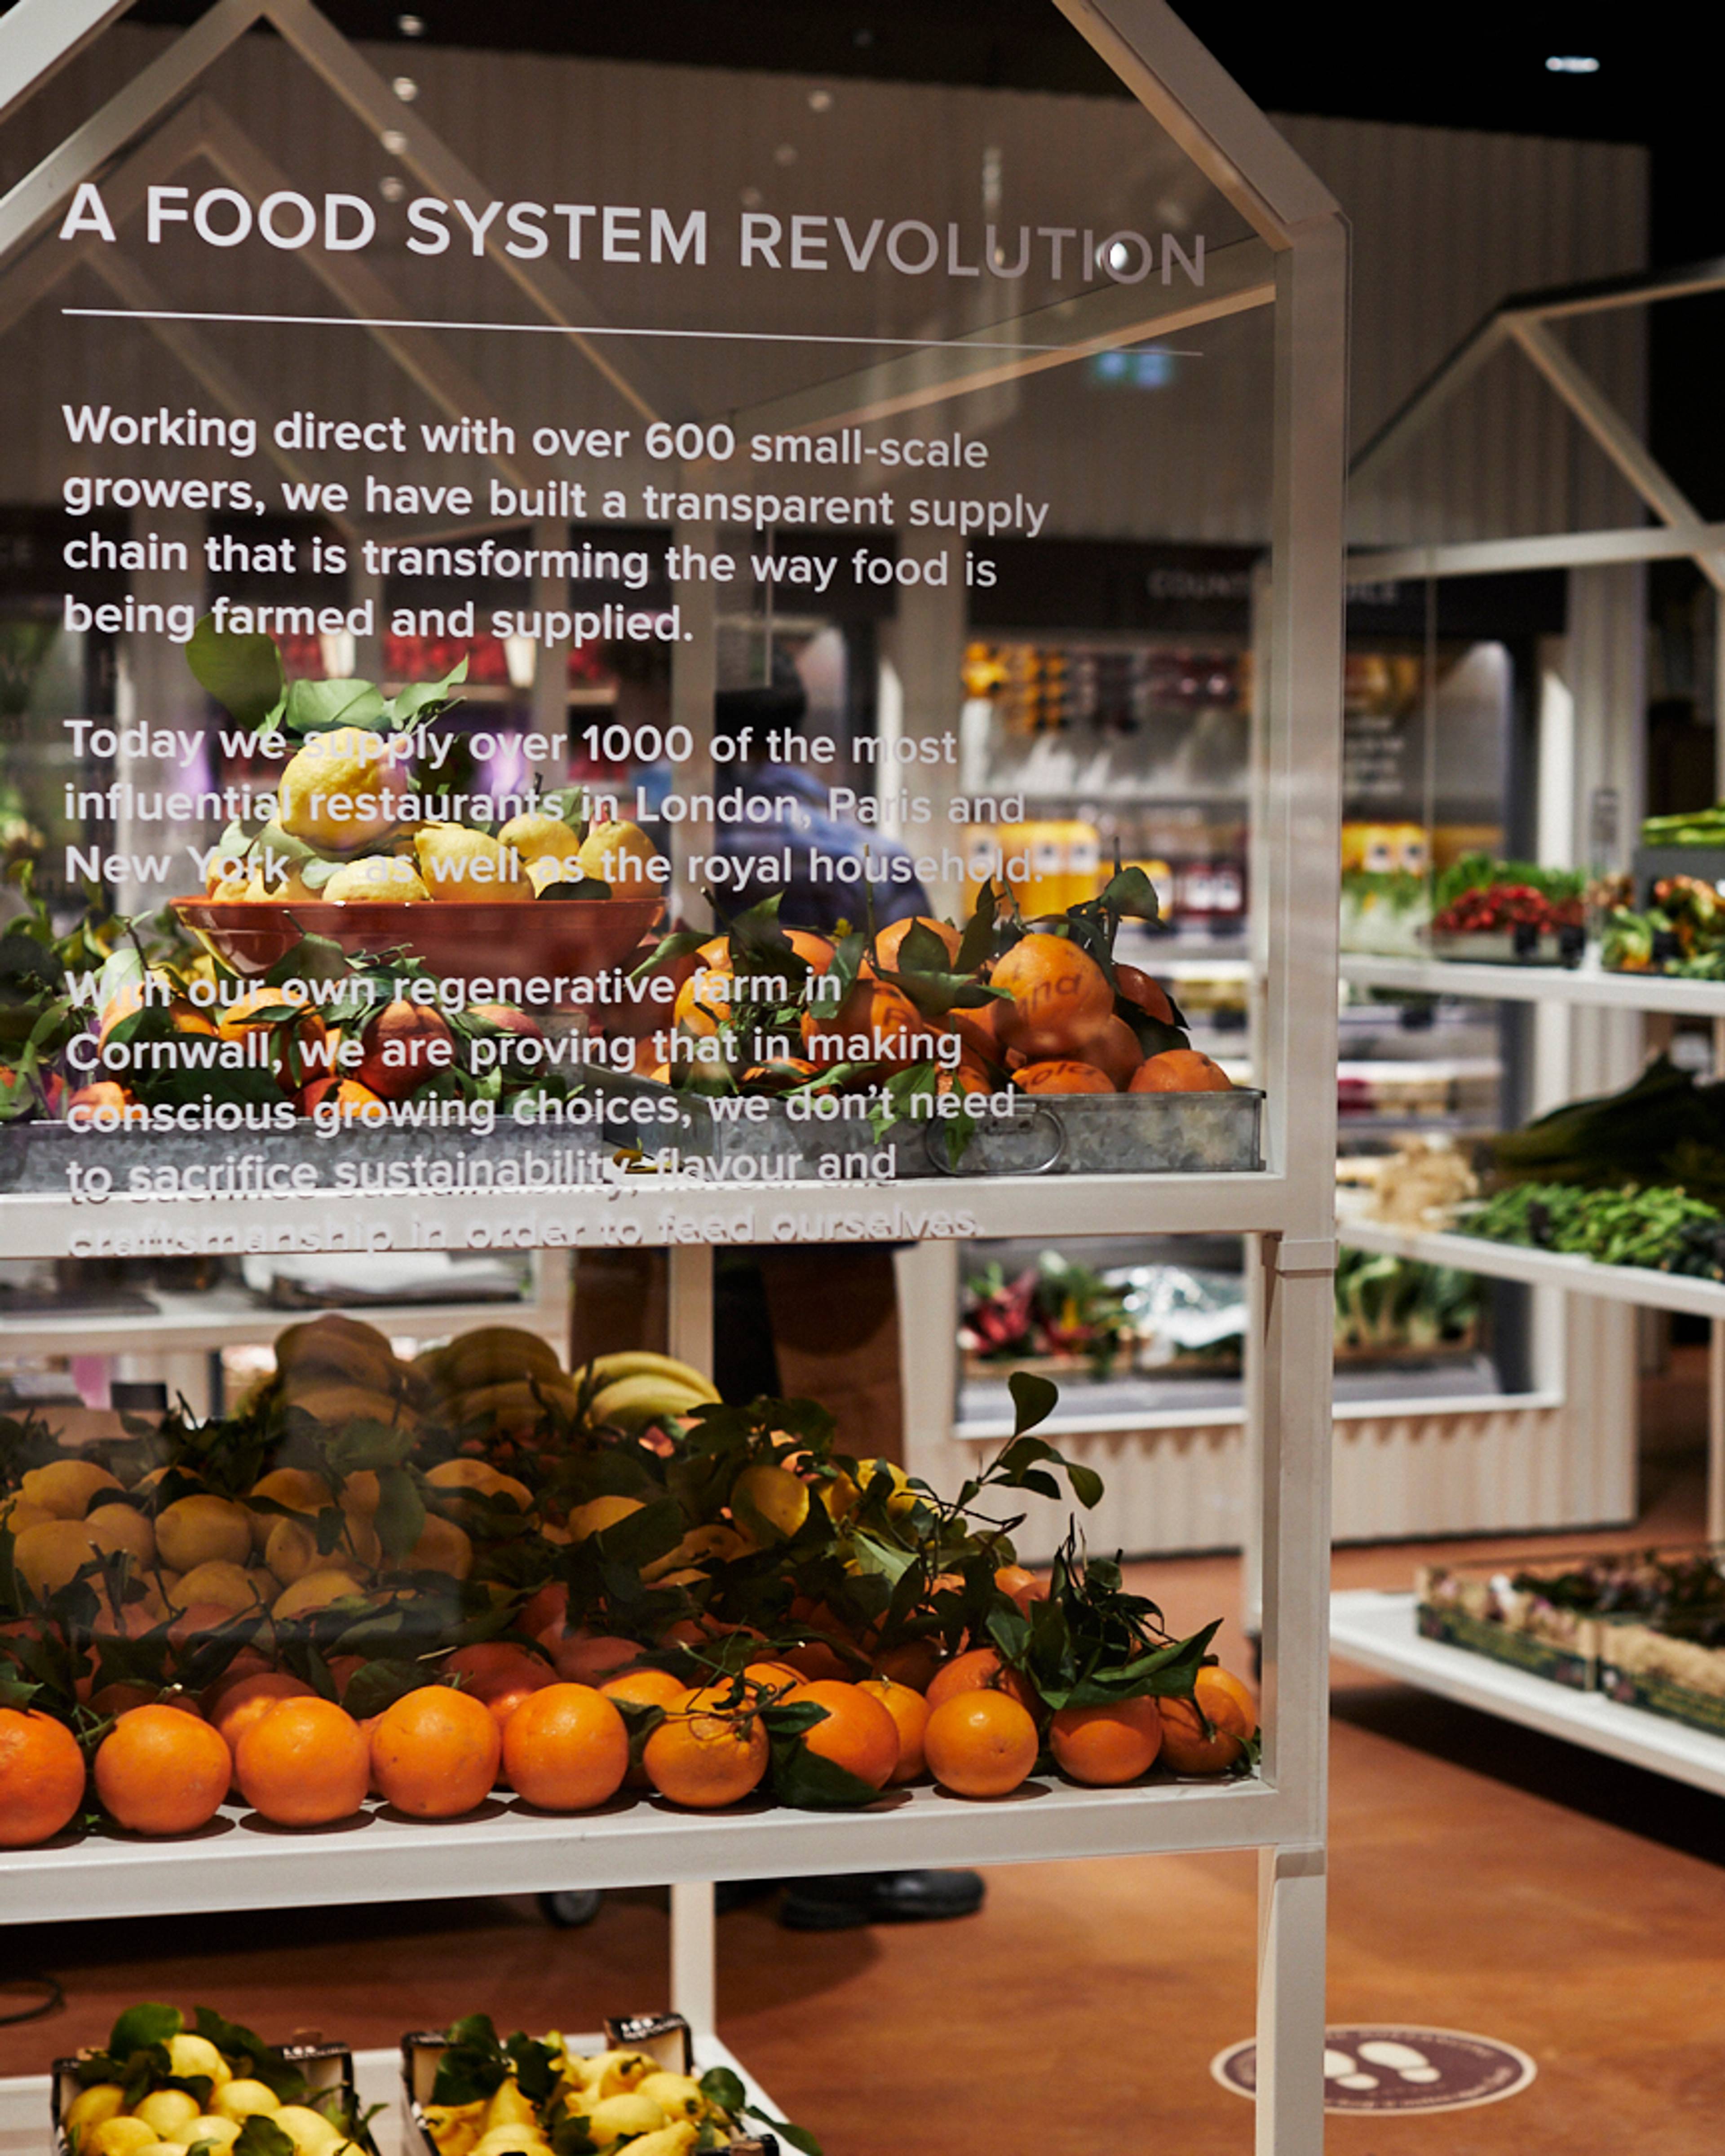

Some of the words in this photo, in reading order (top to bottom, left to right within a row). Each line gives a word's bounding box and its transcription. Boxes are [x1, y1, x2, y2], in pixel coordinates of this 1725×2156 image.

[59, 183, 116, 242] A
[147, 186, 376, 251] FOOD
[406, 198, 707, 265] SYSTEM
[740, 212, 1205, 286] REVOLUTION
[62, 404, 257, 456] Working
[274, 412, 405, 453] direct
[421, 416, 514, 454] with
[533, 429, 630, 458] over
[645, 423, 735, 461] 600
[751, 429, 989, 468] small-scale
[63, 472, 266, 516] growers,
[282, 482, 348, 512] we
[367, 477, 473, 514] have
[491, 480, 586, 517] built
[602, 490, 626, 519] a
[643, 485, 893, 529] transparent
[909, 494, 1049, 536] supply
[64, 533, 188, 570] chain
[204, 535, 296, 573] that
[314, 536, 347, 573] is
[363, 538, 649, 587] transforming
[666, 545, 735, 581] the
[752, 556, 838, 592] way
[853, 549, 948, 585] food
[965, 551, 997, 587] is
[64, 594, 195, 643] being
[211, 598, 374, 636] farmed
[391, 602, 475, 639] and
[491, 604, 692, 647] supplied.
[63, 720, 204, 767] Today
[219, 729, 286, 758] we
[303, 723, 454, 769] supply
[469, 732, 567, 761] over
[582, 725, 693, 764] 1000
[709, 727, 751, 763] of
[766, 727, 836, 763] the
[852, 730, 957, 764] most
[64, 783, 291, 821] influential
[310, 788, 564, 822] restaurants
[581, 787, 618, 822] in
[637, 787, 810, 829] London,
[829, 787, 931, 825] Paris
[948, 793, 1025, 825] and
[66, 845, 170, 883] New
[187, 845, 290, 883] York
[365, 854, 416, 883] as
[431, 846, 518, 883] well
[537, 854, 583, 883] as
[602, 847, 671, 884] the
[687, 847, 792, 891] royal
[810, 847, 1043, 884] household.
[65, 970, 171, 1009] With
[188, 978, 265, 1007] our
[281, 978, 375, 1007] own
[394, 969, 675, 1011] regenerative
[694, 968, 787, 1003] farm
[806, 968, 841, 1003] in
[66, 1031, 282, 1074] Cornwall,
[299, 1037, 364, 1067] we
[382, 1037, 453, 1067] are
[470, 1029, 635, 1073] proving
[653, 1027, 738, 1062] that
[753, 1026, 790, 1061] in
[808, 1025, 962, 1068] making
[67, 1095, 297, 1134] conscious
[313, 1091, 495, 1138] growing
[513, 1090, 691, 1127] choices,
[708, 1091, 770, 1120] we
[910, 1084, 1015, 1118] need
[67, 1160, 112, 1197] to
[129, 1154, 318, 1194] sacrifice
[335, 1150, 637, 1198] sustainability,
[656, 1148, 803, 1182] flavour
[818, 1144, 896, 1181] and
[411, 1212, 448, 1249] in
[466, 1210, 587, 1247] order
[601, 1212, 641, 1245] to
[657, 1207, 754, 1245] feed
[770, 1204, 985, 1243] ourselves.
